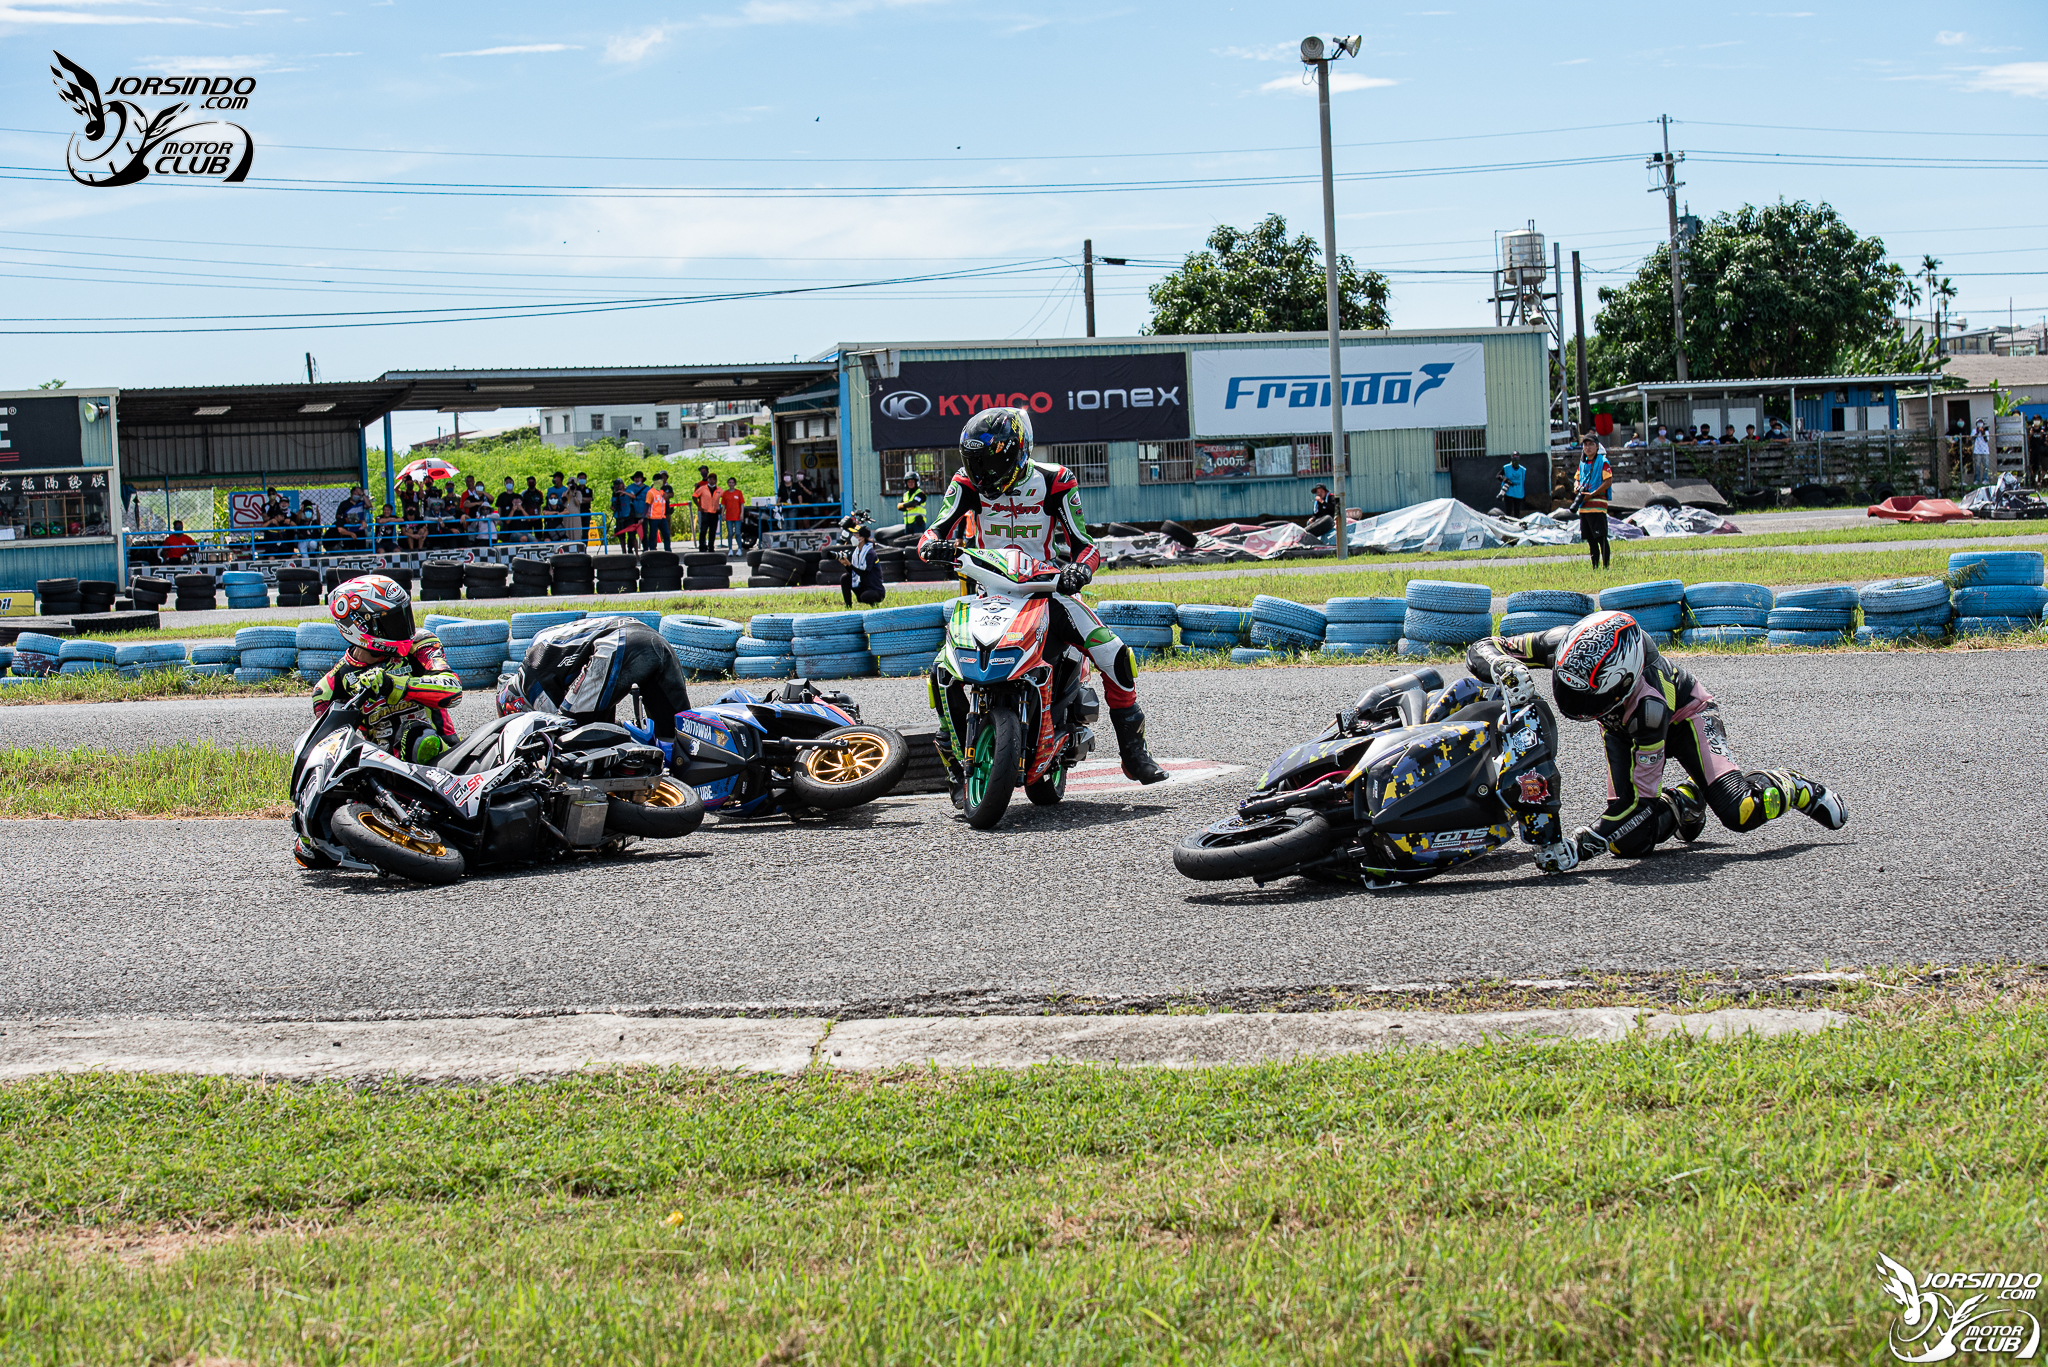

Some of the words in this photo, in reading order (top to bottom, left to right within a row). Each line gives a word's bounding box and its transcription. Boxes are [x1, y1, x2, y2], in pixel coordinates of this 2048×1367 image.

[938, 391, 1053, 416] KYMCO
[1068, 386, 1180, 411] ionex
[1225, 371, 1413, 410] Frando
